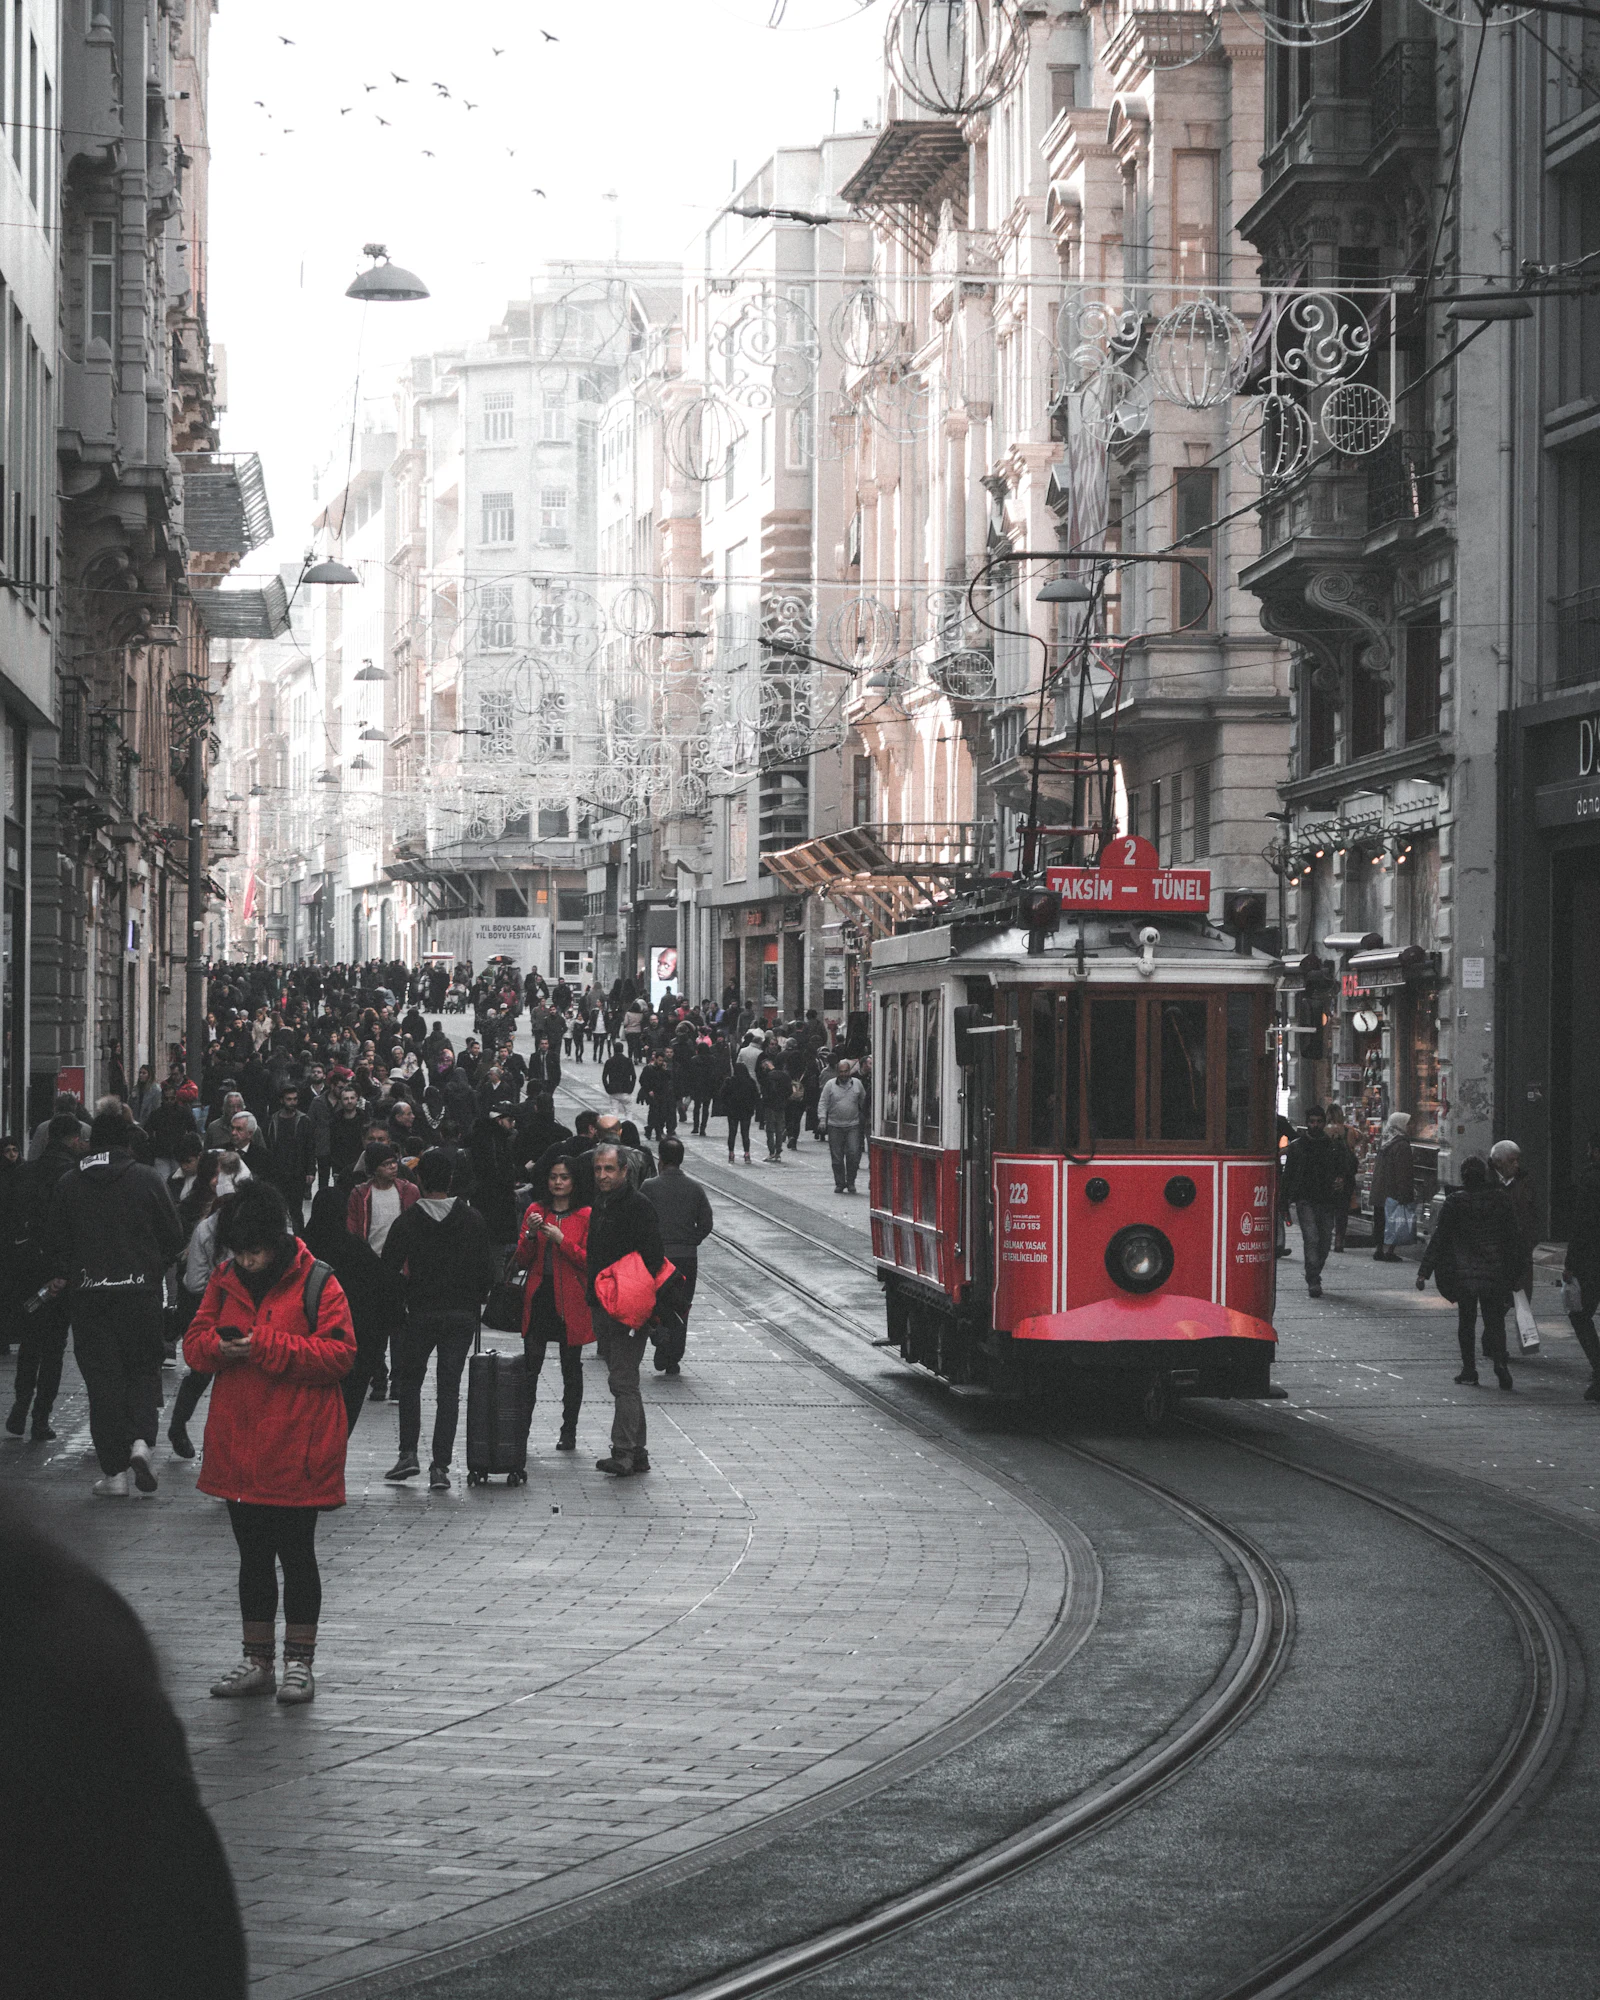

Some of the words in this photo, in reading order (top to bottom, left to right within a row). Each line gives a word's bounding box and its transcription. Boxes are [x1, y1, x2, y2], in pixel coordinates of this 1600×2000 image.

[1123, 839, 1137, 866] 2
[1052, 873, 1113, 900] TAKSİM
[1152, 873, 1205, 901] TÜNEL
[492, 924, 511, 932] BOYU
[512, 924, 537, 932] SANAT
[1009, 1182, 1028, 1205] 223
[1013, 1222, 1026, 1230] ALO
[1026, 1222, 1041, 1231] 153
[1025, 1241, 1047, 1251] YASAK
[1235, 1254, 1244, 1264] VE
